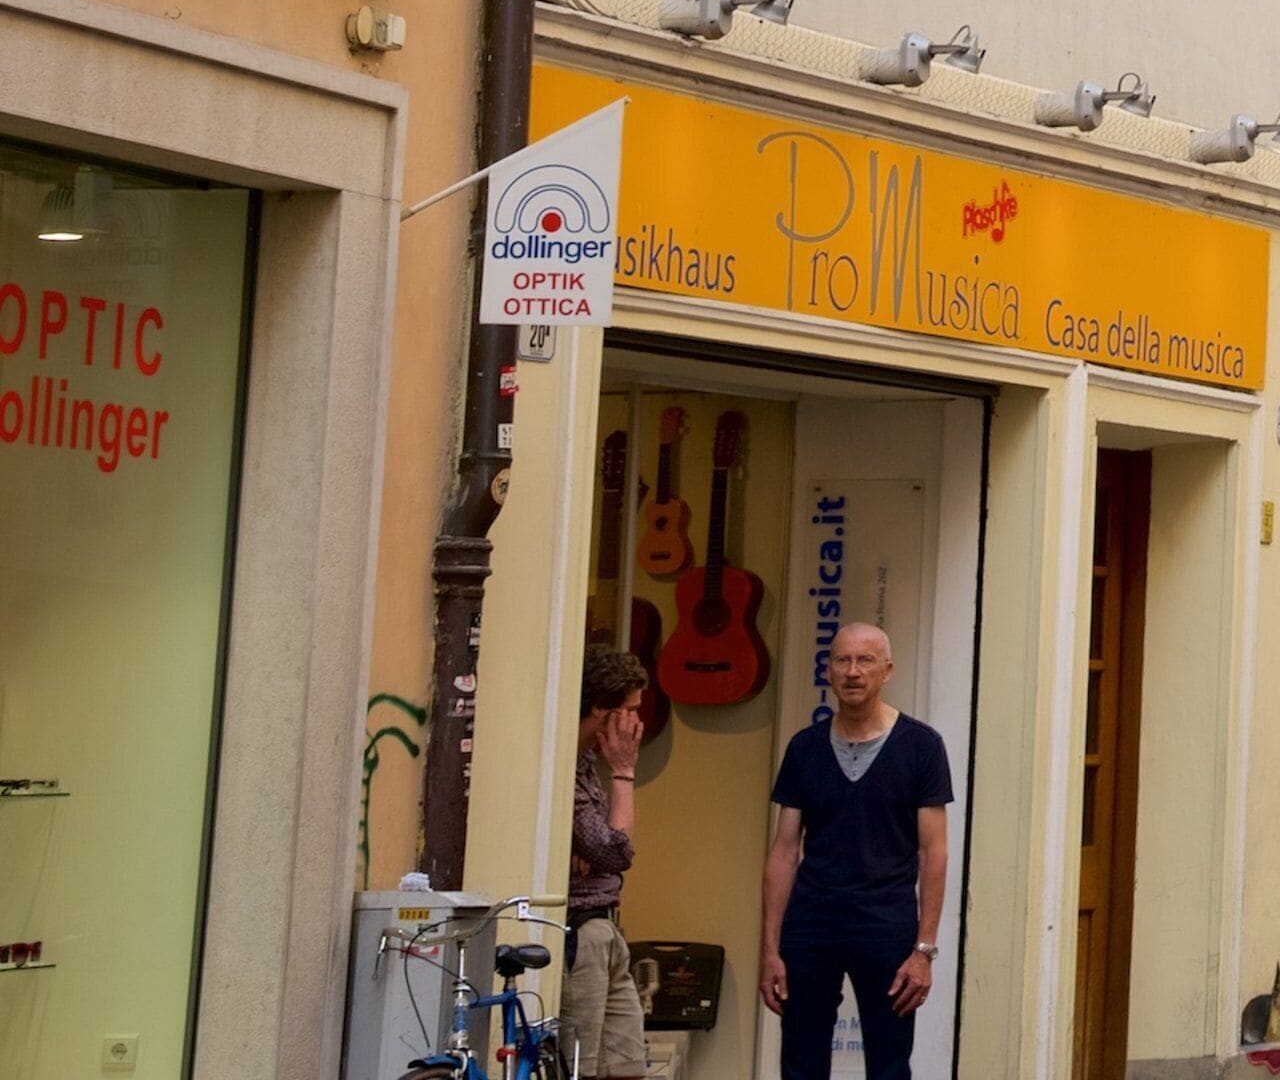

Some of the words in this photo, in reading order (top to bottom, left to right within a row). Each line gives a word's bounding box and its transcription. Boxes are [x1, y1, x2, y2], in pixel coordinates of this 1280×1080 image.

[492, 235, 612, 264] dollinger
[513, 272, 585, 290] OPTIK
[503, 298, 592, 316] OTTICA
[0, 283, 163, 376] OPTIC
[1046, 299, 1100, 353] Casa
[1107, 309, 1161, 364] della
[1167, 331, 1244, 379] musica
